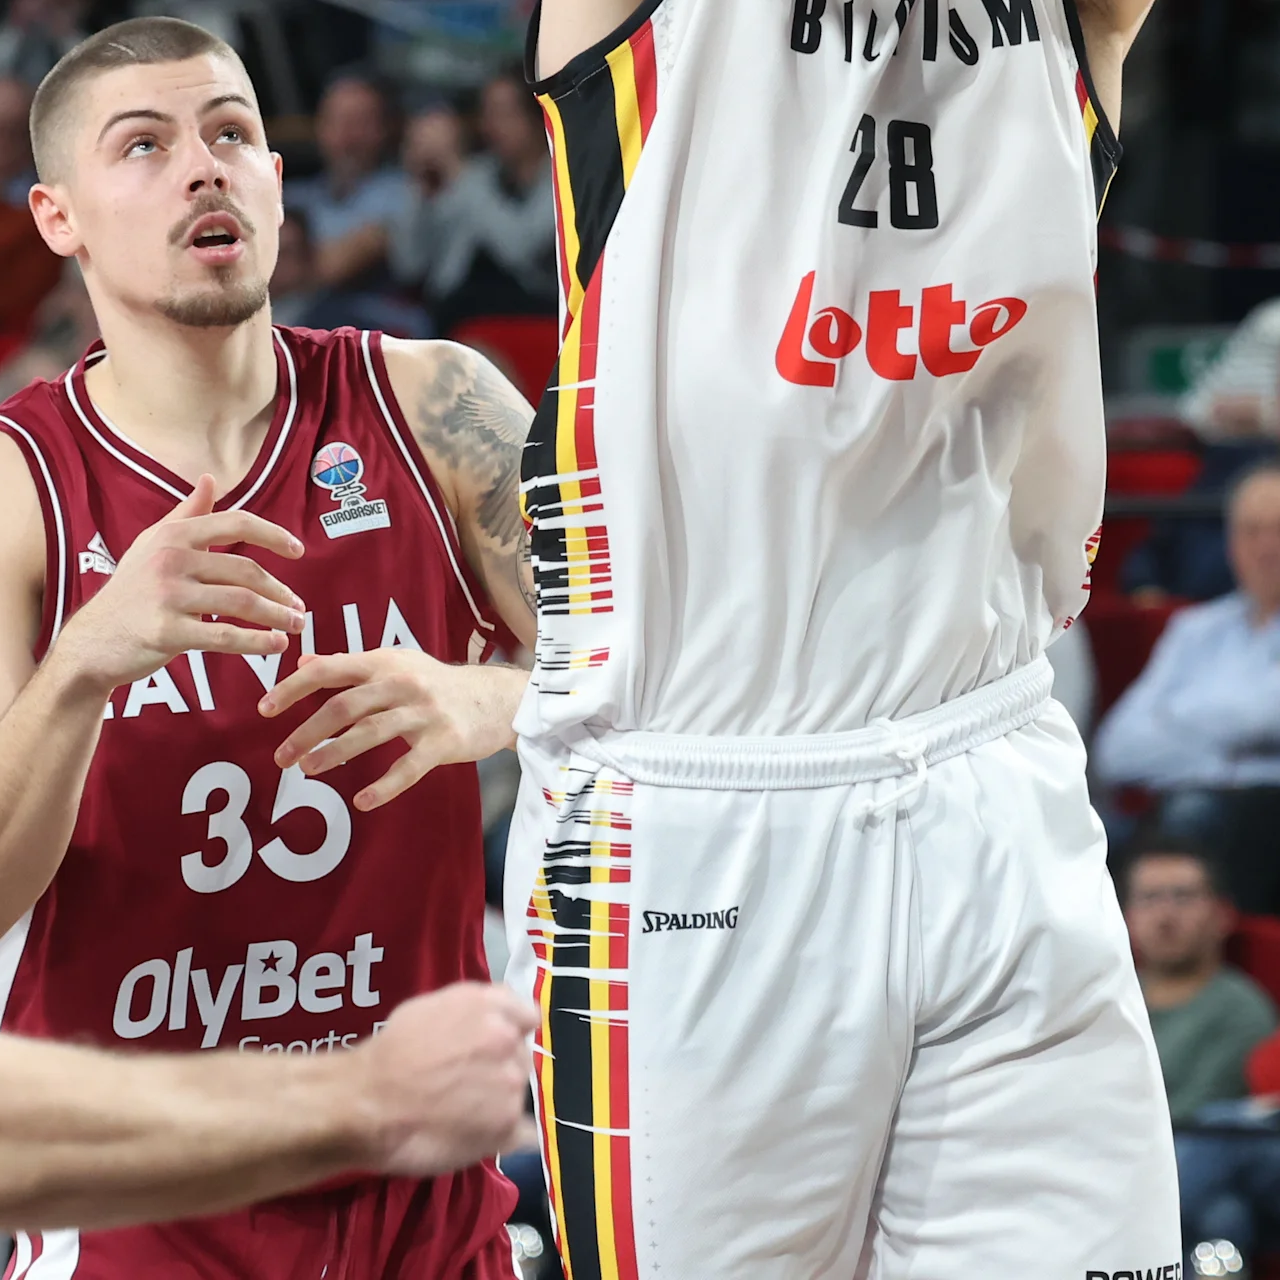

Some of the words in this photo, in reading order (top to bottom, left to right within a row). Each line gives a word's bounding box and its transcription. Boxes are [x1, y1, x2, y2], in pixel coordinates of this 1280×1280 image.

[837, 113, 939, 230] 28
[322, 501, 387, 527] EUROBASKET
[180, 738, 352, 895] 35
[642, 906, 739, 934] SPALDING
[112, 931, 385, 1049] OlyBet
